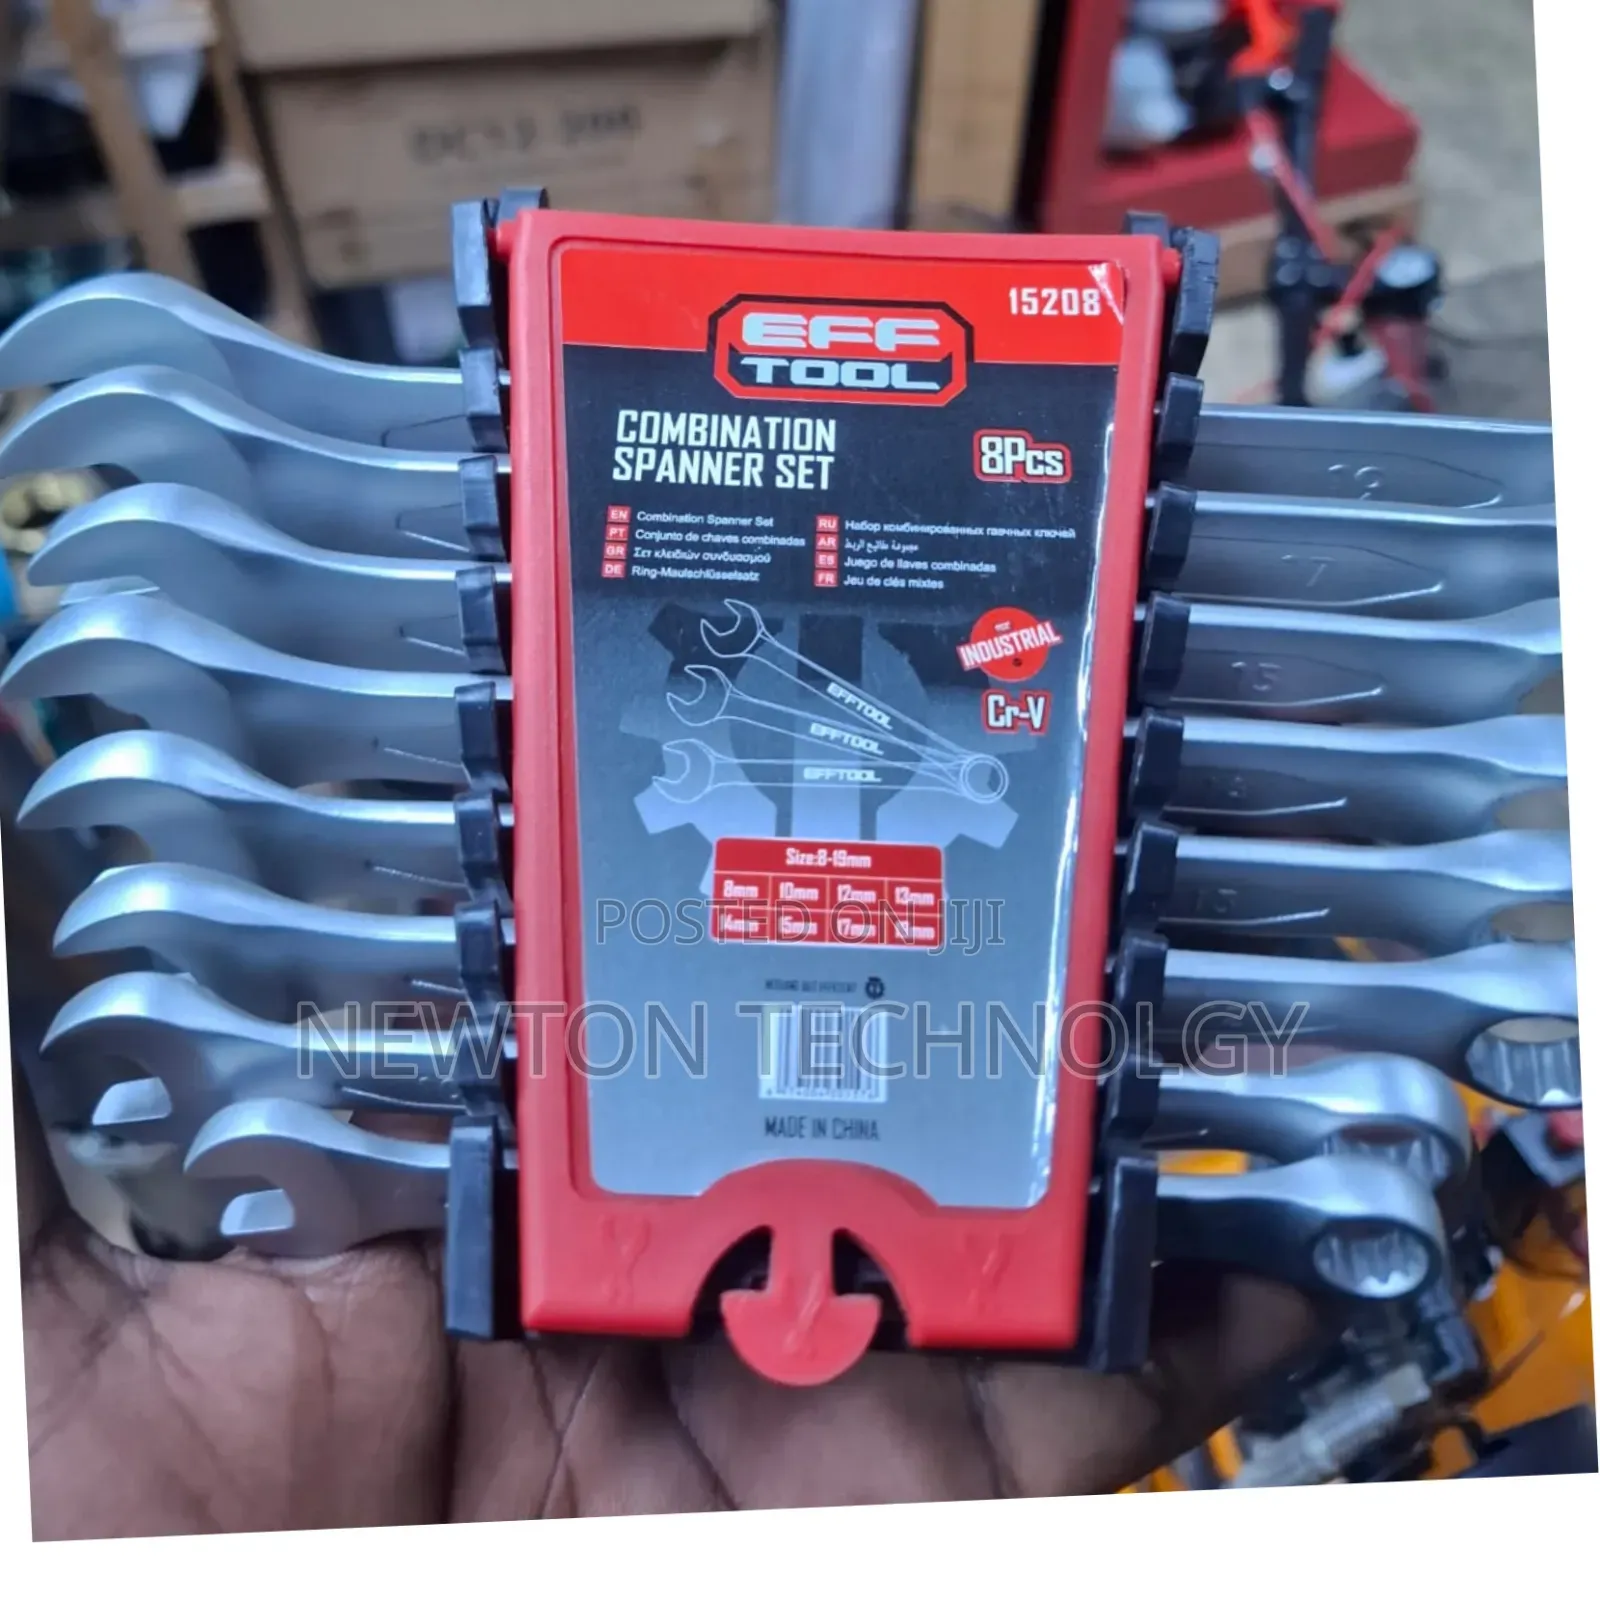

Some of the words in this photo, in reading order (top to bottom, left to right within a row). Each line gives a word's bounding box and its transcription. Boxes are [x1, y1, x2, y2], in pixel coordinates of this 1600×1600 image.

[1008, 287, 1100, 316] 15208
[742, 312, 940, 352] EFF
[741, 356, 940, 391] TOOL
[616, 409, 836, 453] COMBINATION
[980, 434, 1064, 478] 8Pcs
[612, 447, 764, 487] SPANNER
[775, 454, 835, 490] SET
[610, 509, 628, 520] EN
[636, 510, 705, 524] Combination
[707, 514, 752, 527] Spanner
[755, 516, 774, 527] Set
[818, 519, 837, 530] RU
[844, 520, 881, 533] Набор
[609, 527, 625, 538] PT
[635, 528, 683, 541] Conjunto
[685, 531, 699, 542] de
[701, 532, 740, 543] chaves
[741, 533, 806, 547] combinadas
[817, 537, 836, 548] AR
[606, 546, 624, 557] GR
[633, 547, 652, 558] Σετ
[604, 564, 621, 575] DE
[818, 556, 835, 566] ES
[844, 557, 878, 570] Juego
[881, 558, 894, 569] de
[897, 559, 929, 571] llaves
[931, 560, 996, 573] combinadas
[817, 574, 835, 584] FR
[843, 575, 865, 587] Jeu
[867, 576, 881, 587] de
[884, 576, 906, 588] clés
[908, 577, 944, 590] mixtes
[960, 621, 1062, 668] INDUSTRIAL
[987, 694, 1045, 729] Cr-V
[785, 847, 872, 869] Size:8-19mm
[723, 880, 759, 898] 8mm
[779, 882, 819, 901] 10mm
[837, 884, 877, 904] 12mm
[895, 887, 935, 906] 13mm
[764, 1115, 807, 1139] MADE
[811, 1117, 827, 1139] IN
[832, 1117, 880, 1141] CHINA
